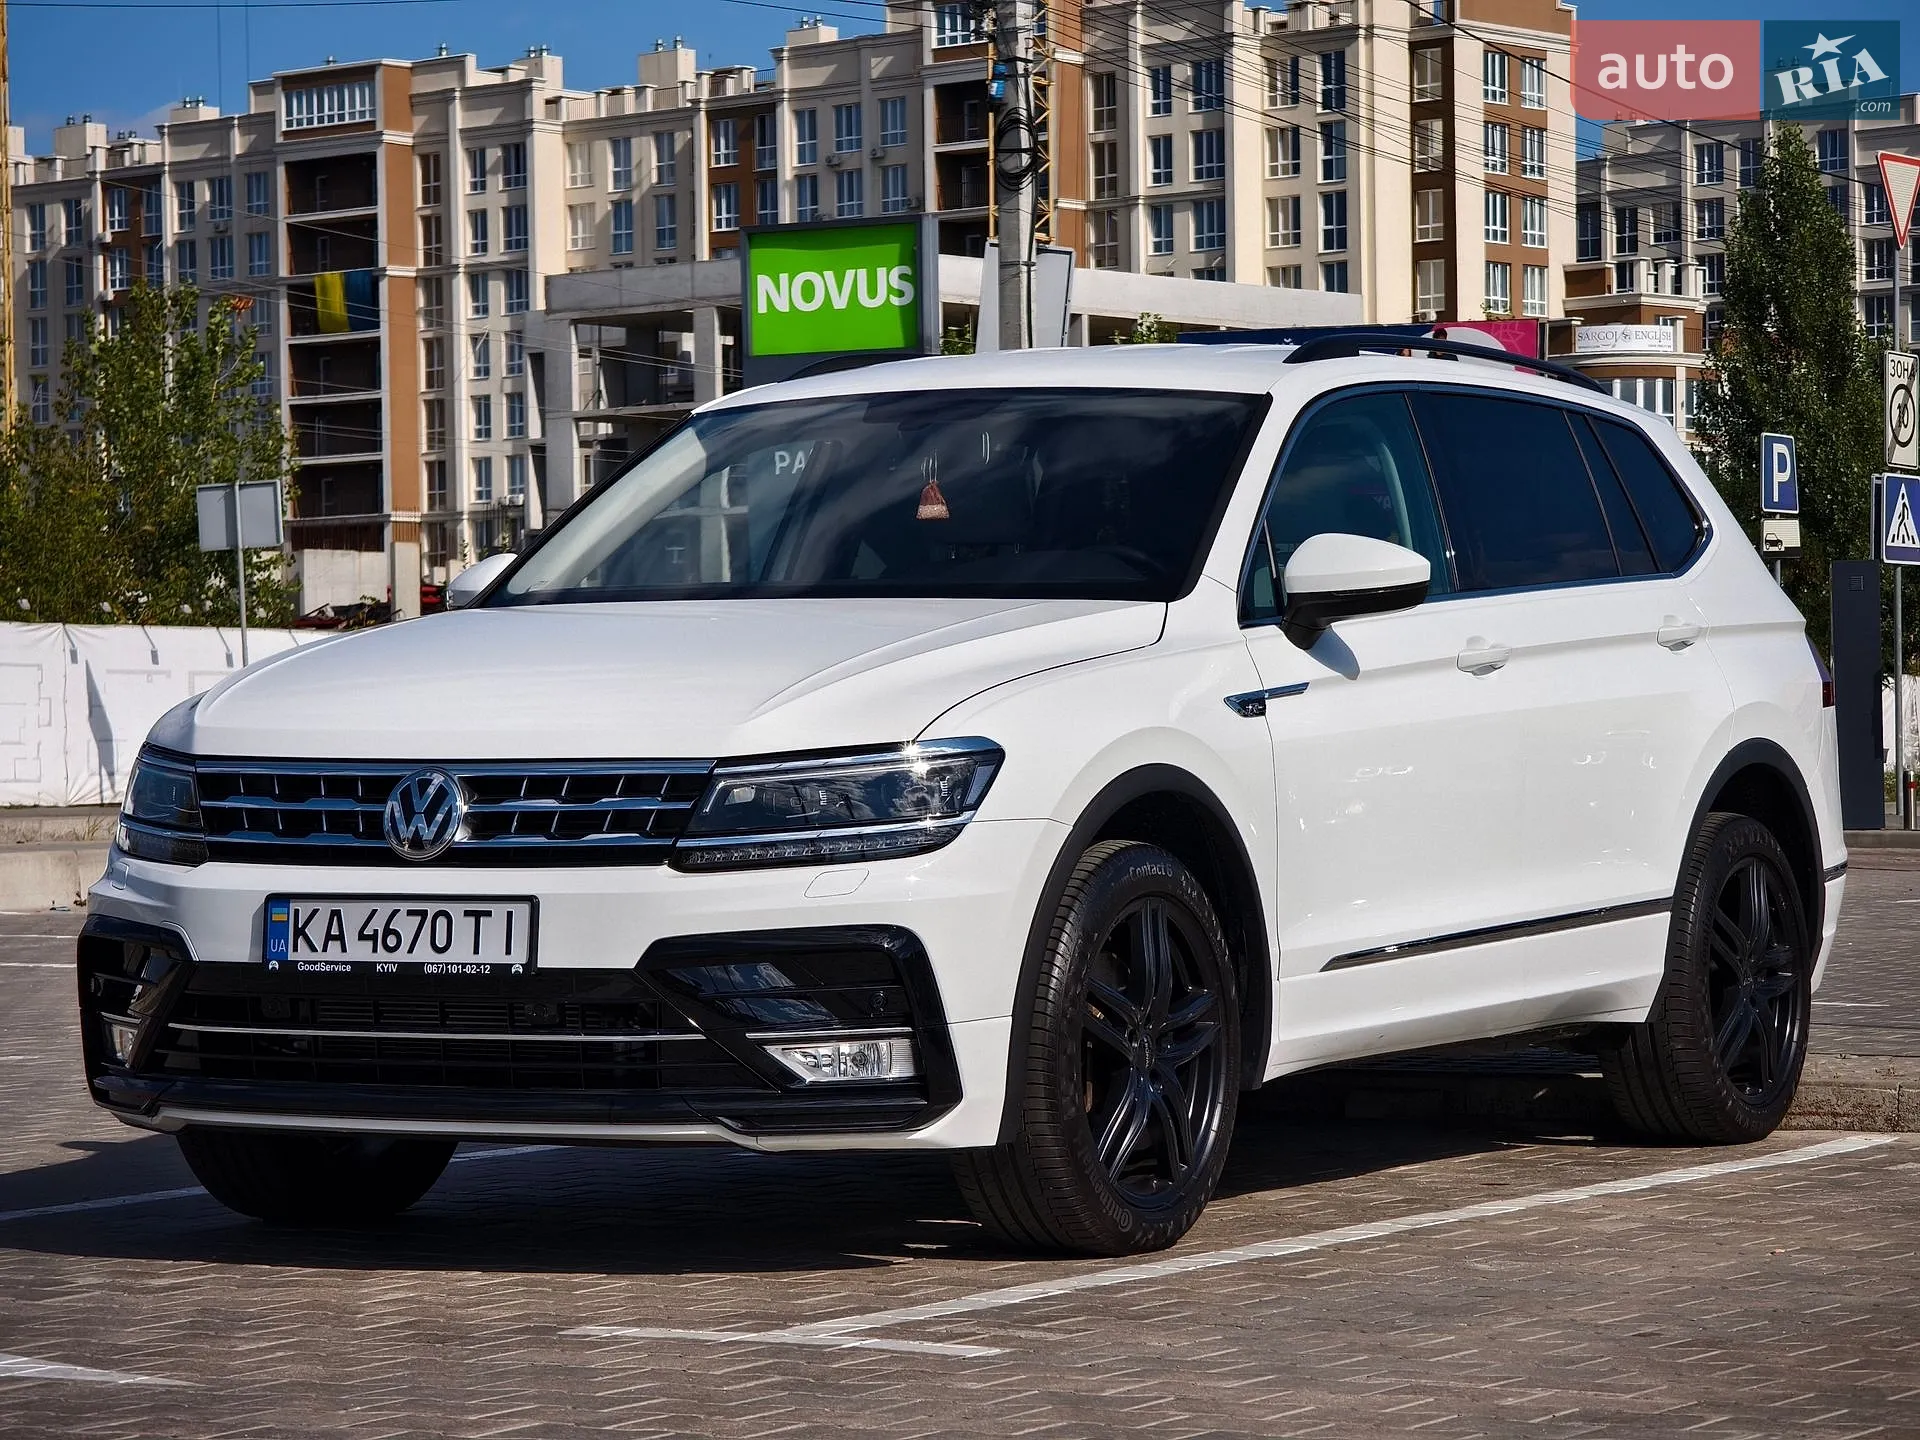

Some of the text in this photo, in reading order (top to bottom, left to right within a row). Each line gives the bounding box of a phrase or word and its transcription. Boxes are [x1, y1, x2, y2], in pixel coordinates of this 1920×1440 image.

[757, 265, 915, 314] NOVUS
[1773, 443, 1791, 502] P
[270, 939, 287, 953] UA
[292, 908, 348, 954] KA
[358, 908, 454, 955] 4670
[297, 962, 352, 973] GoodService
[376, 963, 399, 974] KYIV
